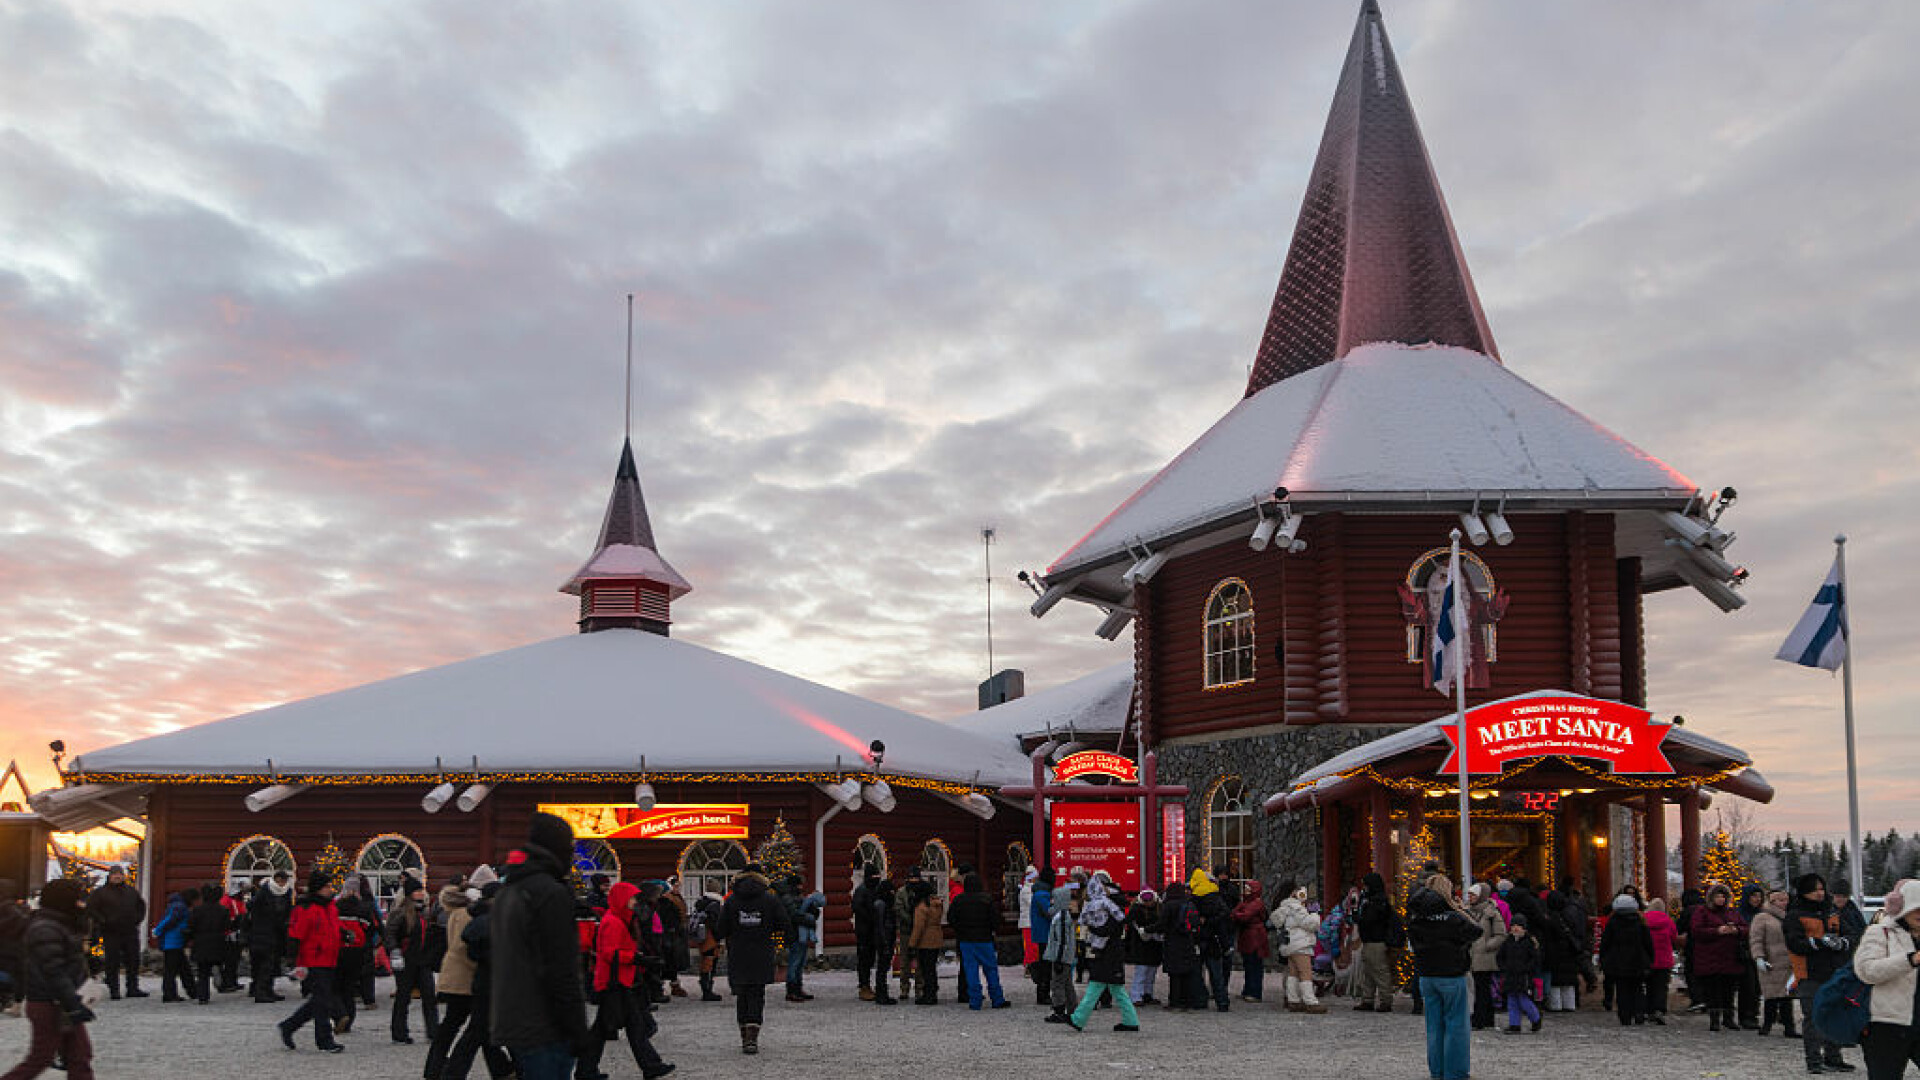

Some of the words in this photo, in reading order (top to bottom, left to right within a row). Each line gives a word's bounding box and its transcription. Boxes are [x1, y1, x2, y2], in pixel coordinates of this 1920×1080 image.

[1512, 704, 1567, 716] CHRISTMAS
[1568, 704, 1600, 716] HOUSE
[1477, 717, 1552, 745] MEET
[1557, 717, 1634, 745] SANTA
[641, 820, 670, 837] Meet
[671, 815, 700, 828] Santa
[702, 814, 730, 823] here!
